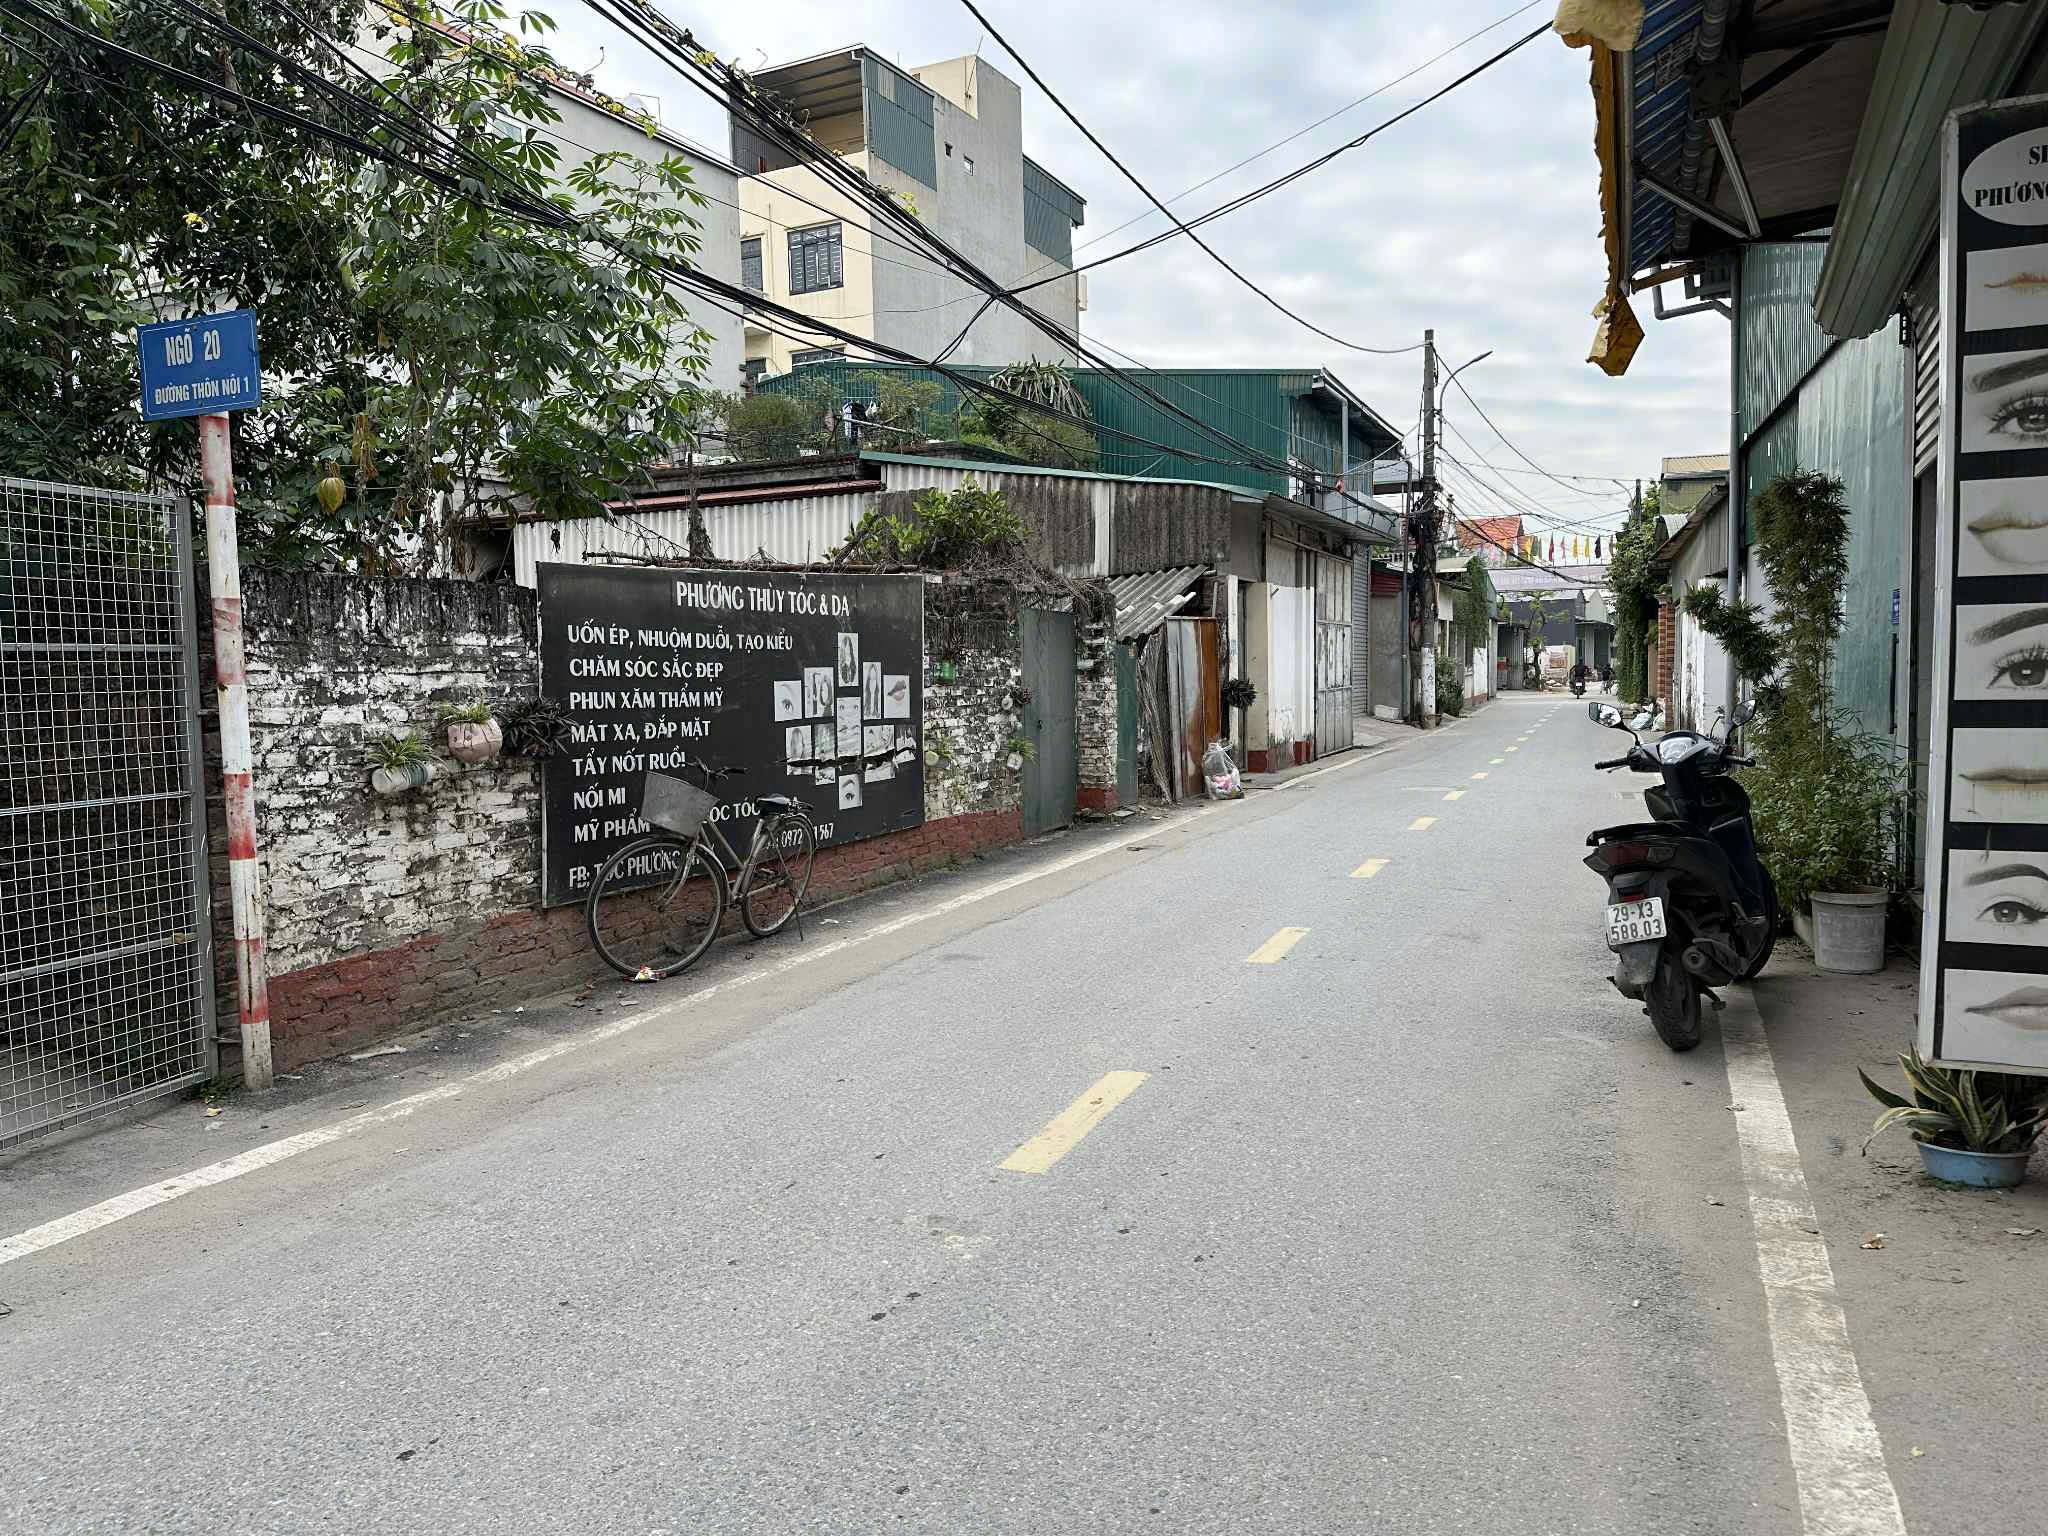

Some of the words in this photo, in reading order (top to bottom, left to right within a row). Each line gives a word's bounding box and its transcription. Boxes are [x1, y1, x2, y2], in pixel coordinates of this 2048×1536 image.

[1976, 181, 2048, 208] PHƯƠN
[165, 328, 193, 367] NGÕ
[204, 330, 220, 361] 20
[155, 382, 190, 405] ĐƯỜNG
[192, 377, 219, 399] THÔN
[222, 373, 241, 398] NỘI
[243, 376, 249, 393] 1
[676, 581, 744, 611] PHƯƠNG
[748, 582, 784, 613] THÙY
[788, 585, 816, 615] TÓC
[820, 594, 828, 616] &
[832, 595, 850, 616] DA
[567, 618, 605, 644] UỐN
[609, 624, 634, 650] ÉP,
[638, 627, 692, 652] NHUỘM
[736, 634, 764, 653] TẠO
[766, 628, 793, 650] KIỂU
[569, 655, 621, 677] CHĂM
[624, 656, 658, 678] SÓC
[662, 654, 692, 678] SẮC
[695, 662, 724, 682] ĐẸP
[570, 691, 616, 710] PHUN
[620, 688, 656, 708] XĂM
[659, 682, 700, 708] THẨM
[704, 687, 724, 707] MỸ
[571, 720, 608, 744] MÁT
[612, 724, 640, 743] XA,
[644, 714, 678, 740] ĐẮP
[681, 717, 711, 741] MẶT
[572, 747, 607, 776] TẨY
[612, 748, 645, 773] NỐT
[573, 783, 604, 810] NỐI
[608, 787, 626, 806] MI
[574, 818, 600, 843] MỸ
[604, 808, 650, 838] PHẨM
[568, 866, 591, 889] FB:
[1613, 902, 1654, 924] 29-X3
[1610, 919, 1662, 942] 588.03
